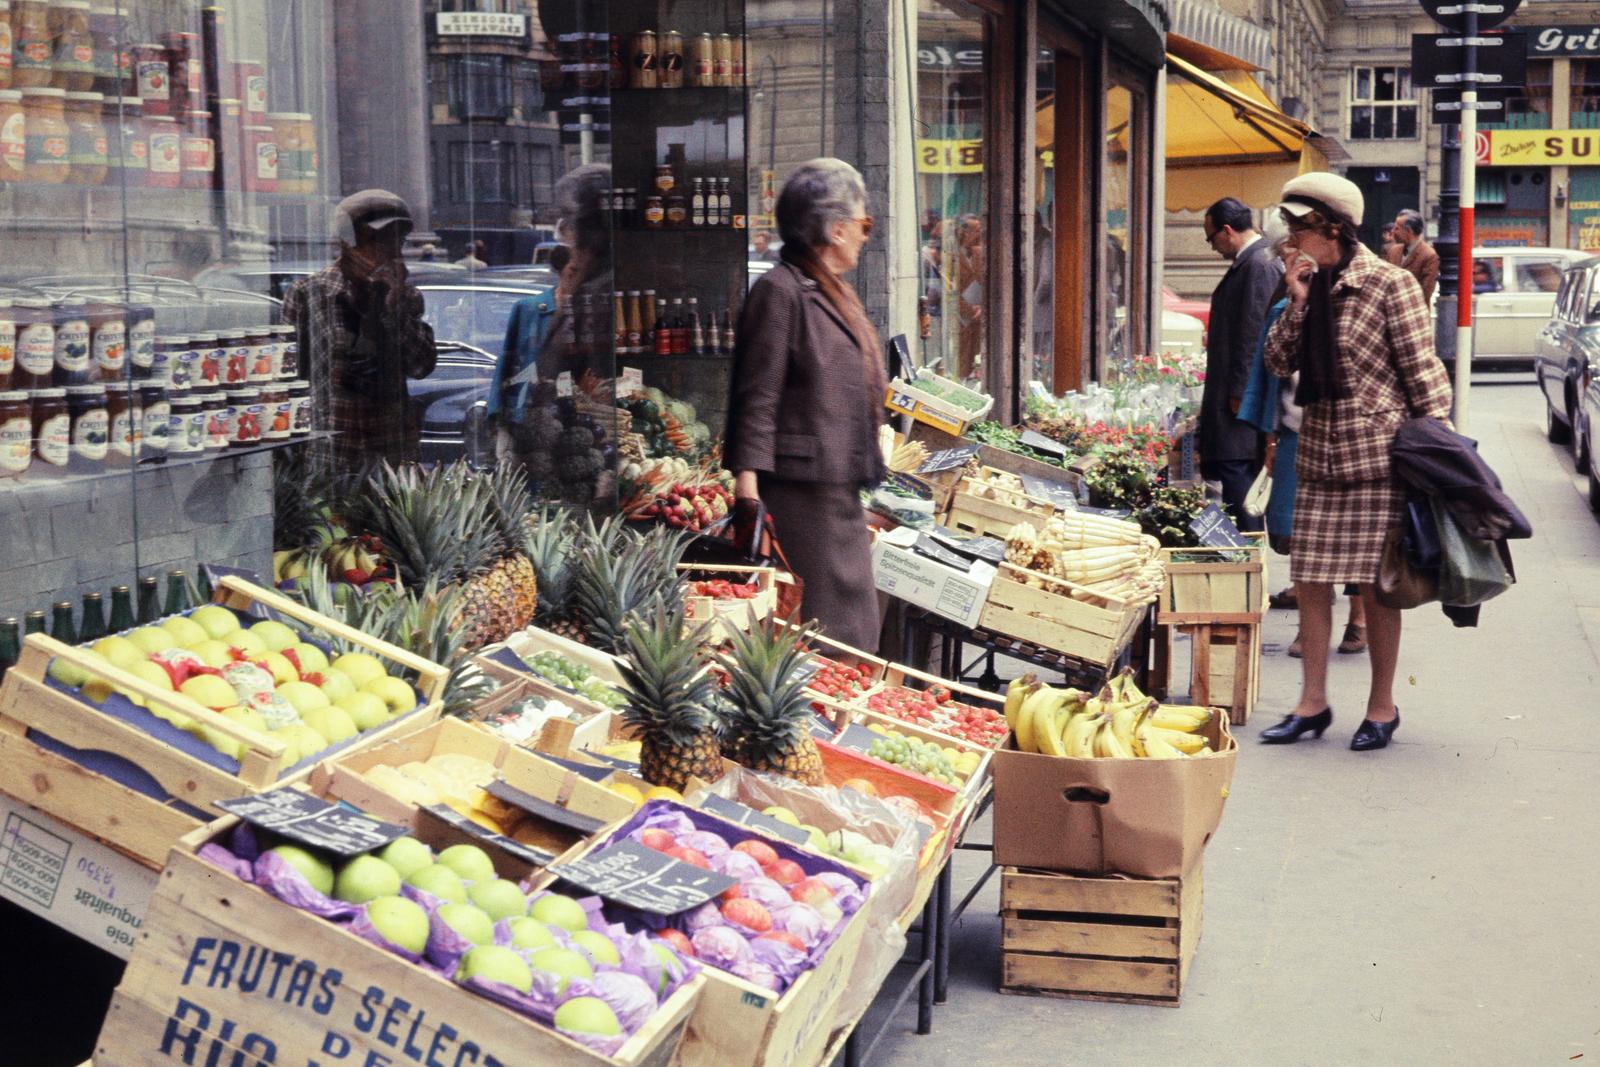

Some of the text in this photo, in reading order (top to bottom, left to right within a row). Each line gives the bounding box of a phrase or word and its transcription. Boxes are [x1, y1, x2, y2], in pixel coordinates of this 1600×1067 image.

[1544, 137, 1600, 157] SU
[106, 925, 136, 947] reie
[181, 937, 343, 1016] FRUTAS
